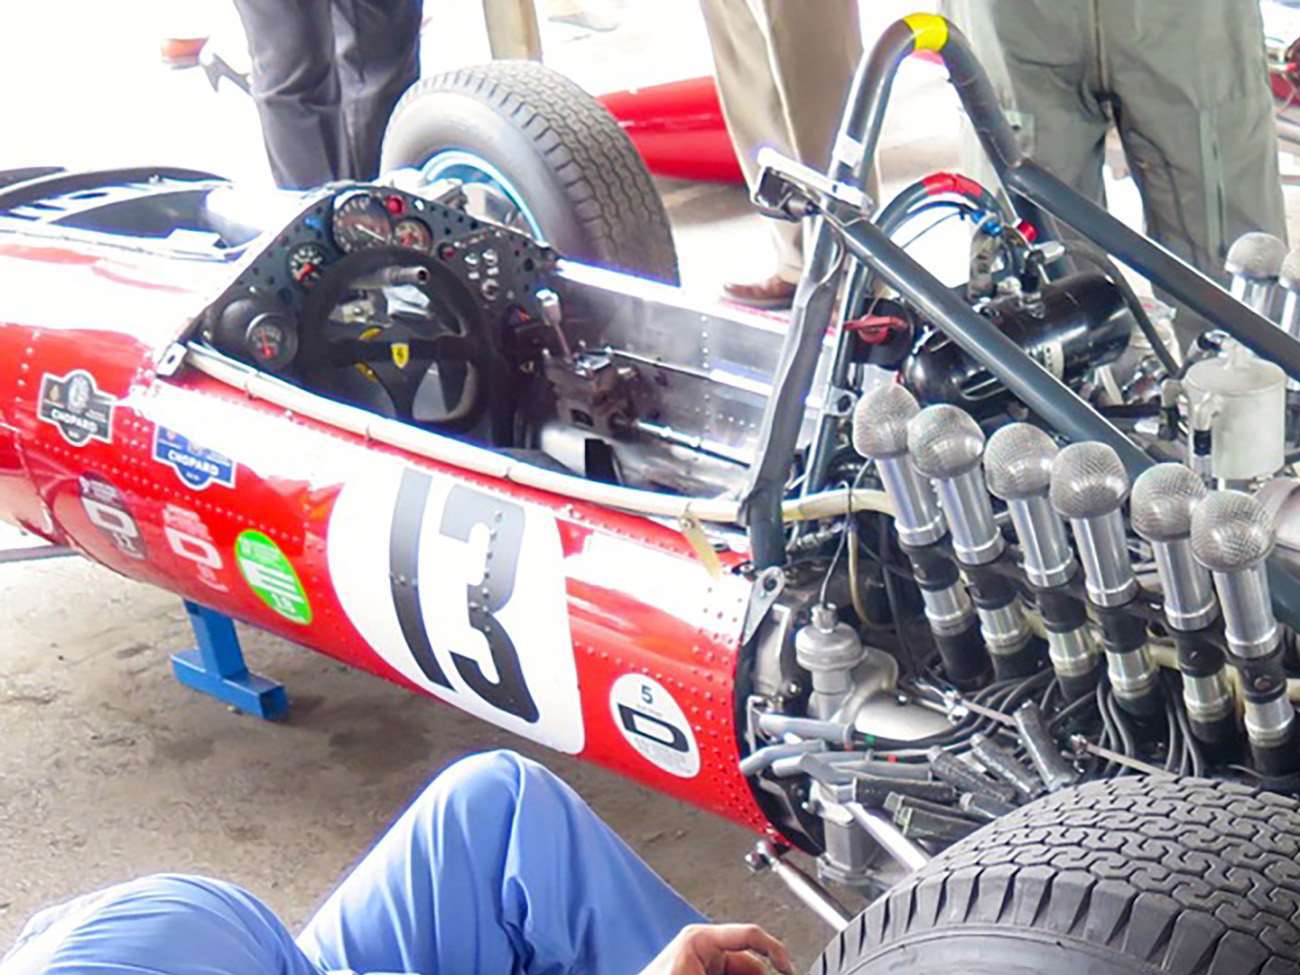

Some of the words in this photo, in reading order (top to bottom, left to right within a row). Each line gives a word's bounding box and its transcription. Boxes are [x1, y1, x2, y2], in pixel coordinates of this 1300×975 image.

[168, 449, 220, 476] CHOPARD
[389, 467, 540, 725] 13
[640, 684, 654, 705] 5
[617, 703, 690, 753] D
